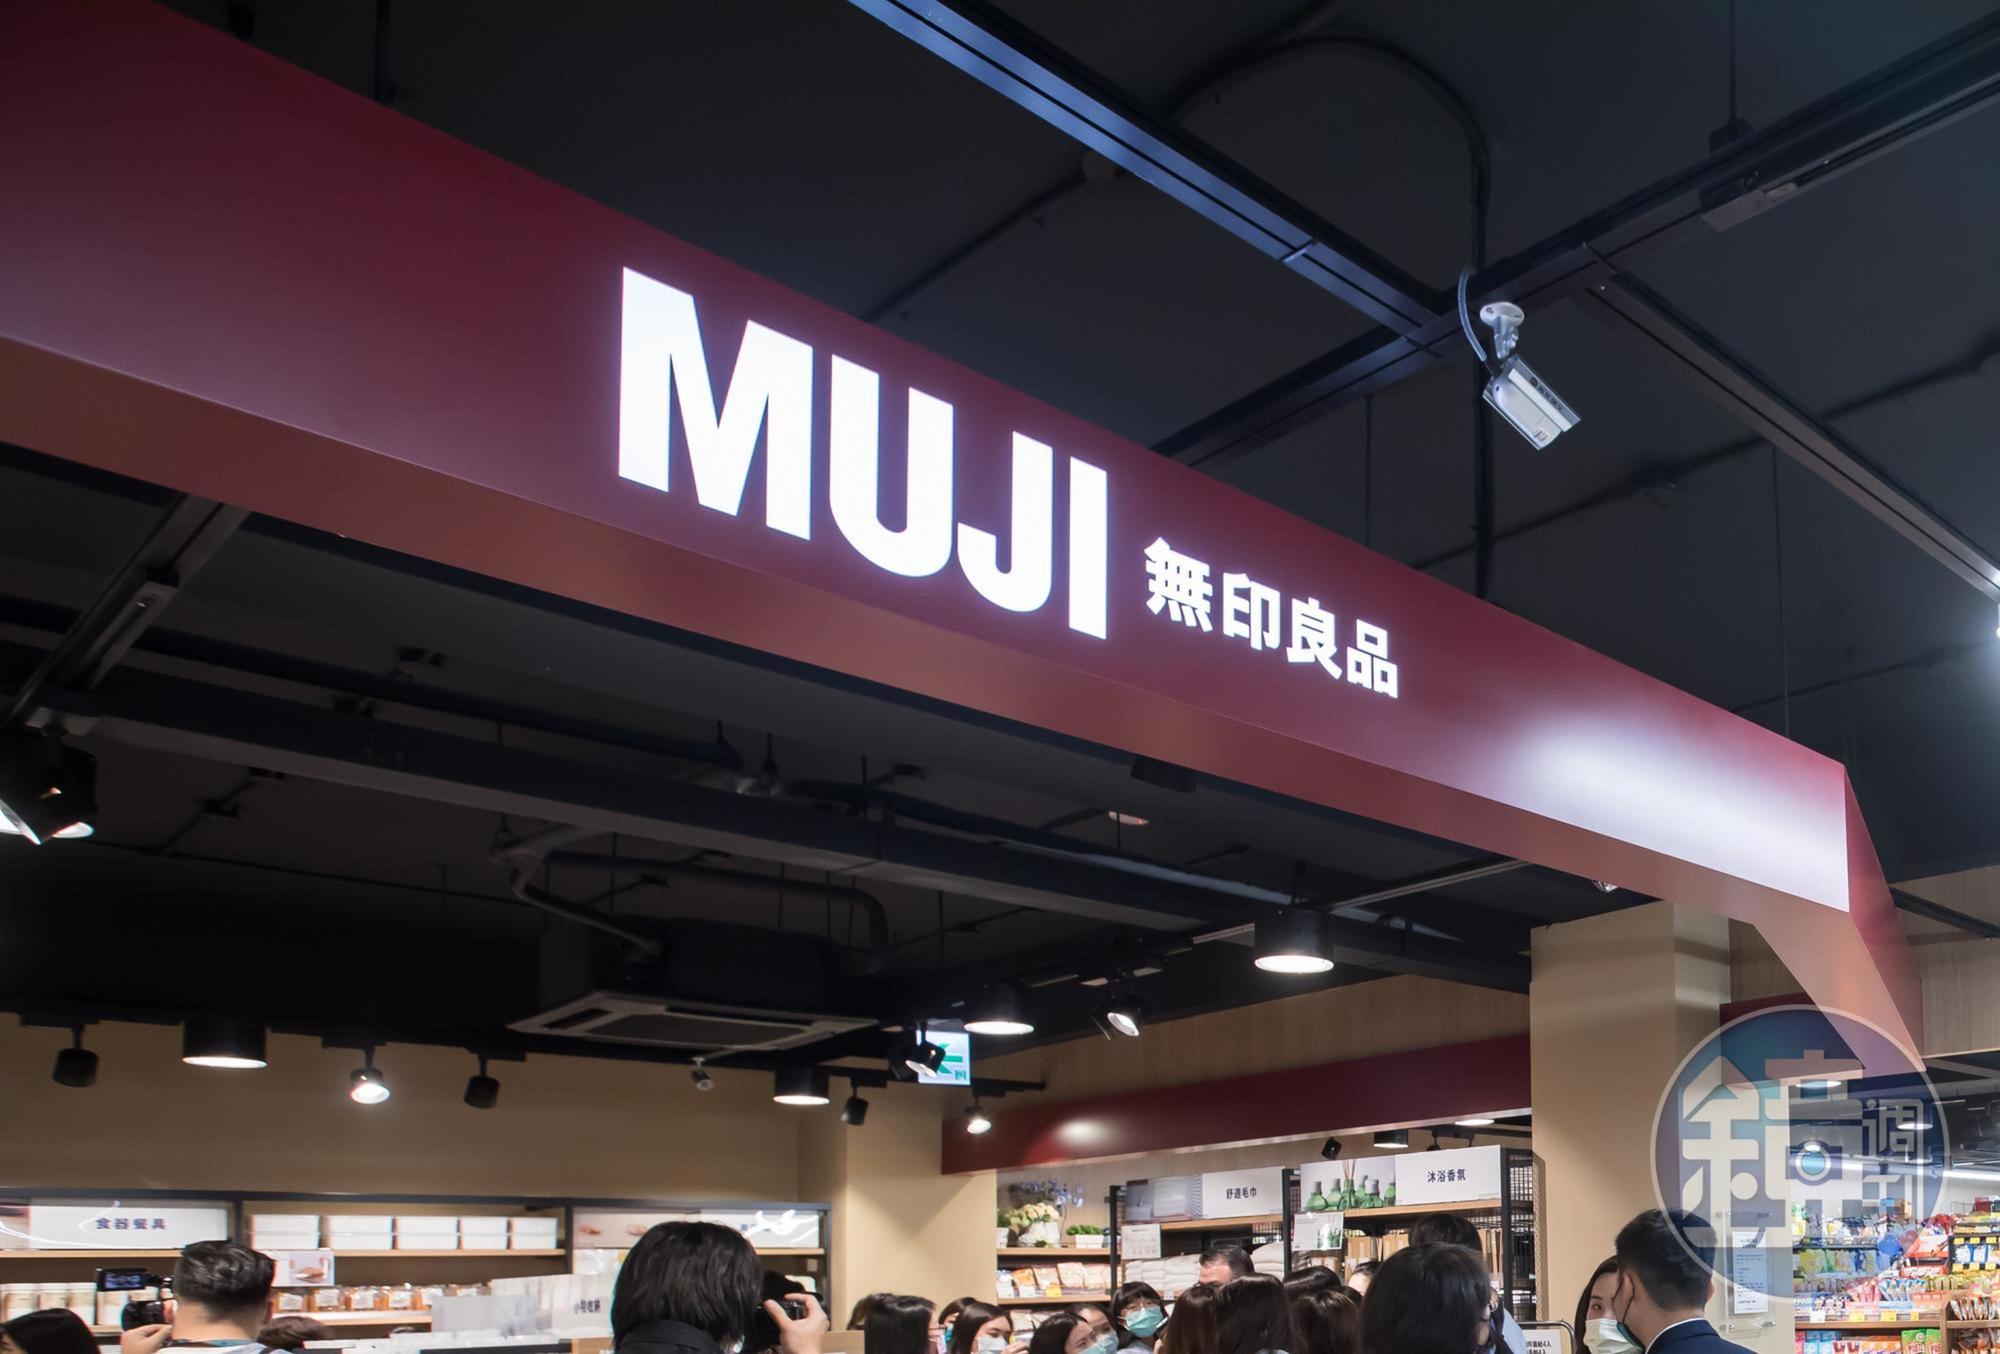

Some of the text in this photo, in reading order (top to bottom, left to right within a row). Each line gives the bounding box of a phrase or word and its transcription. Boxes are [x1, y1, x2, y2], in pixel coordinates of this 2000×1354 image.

[617, 266, 1400, 699] MUJI 無印良品
[1427, 1168, 1466, 1183] 沐浴香氛
[1226, 1186, 1257, 1200] 舒適毛巾
[96, 1217, 166, 1230] 食器餐具
